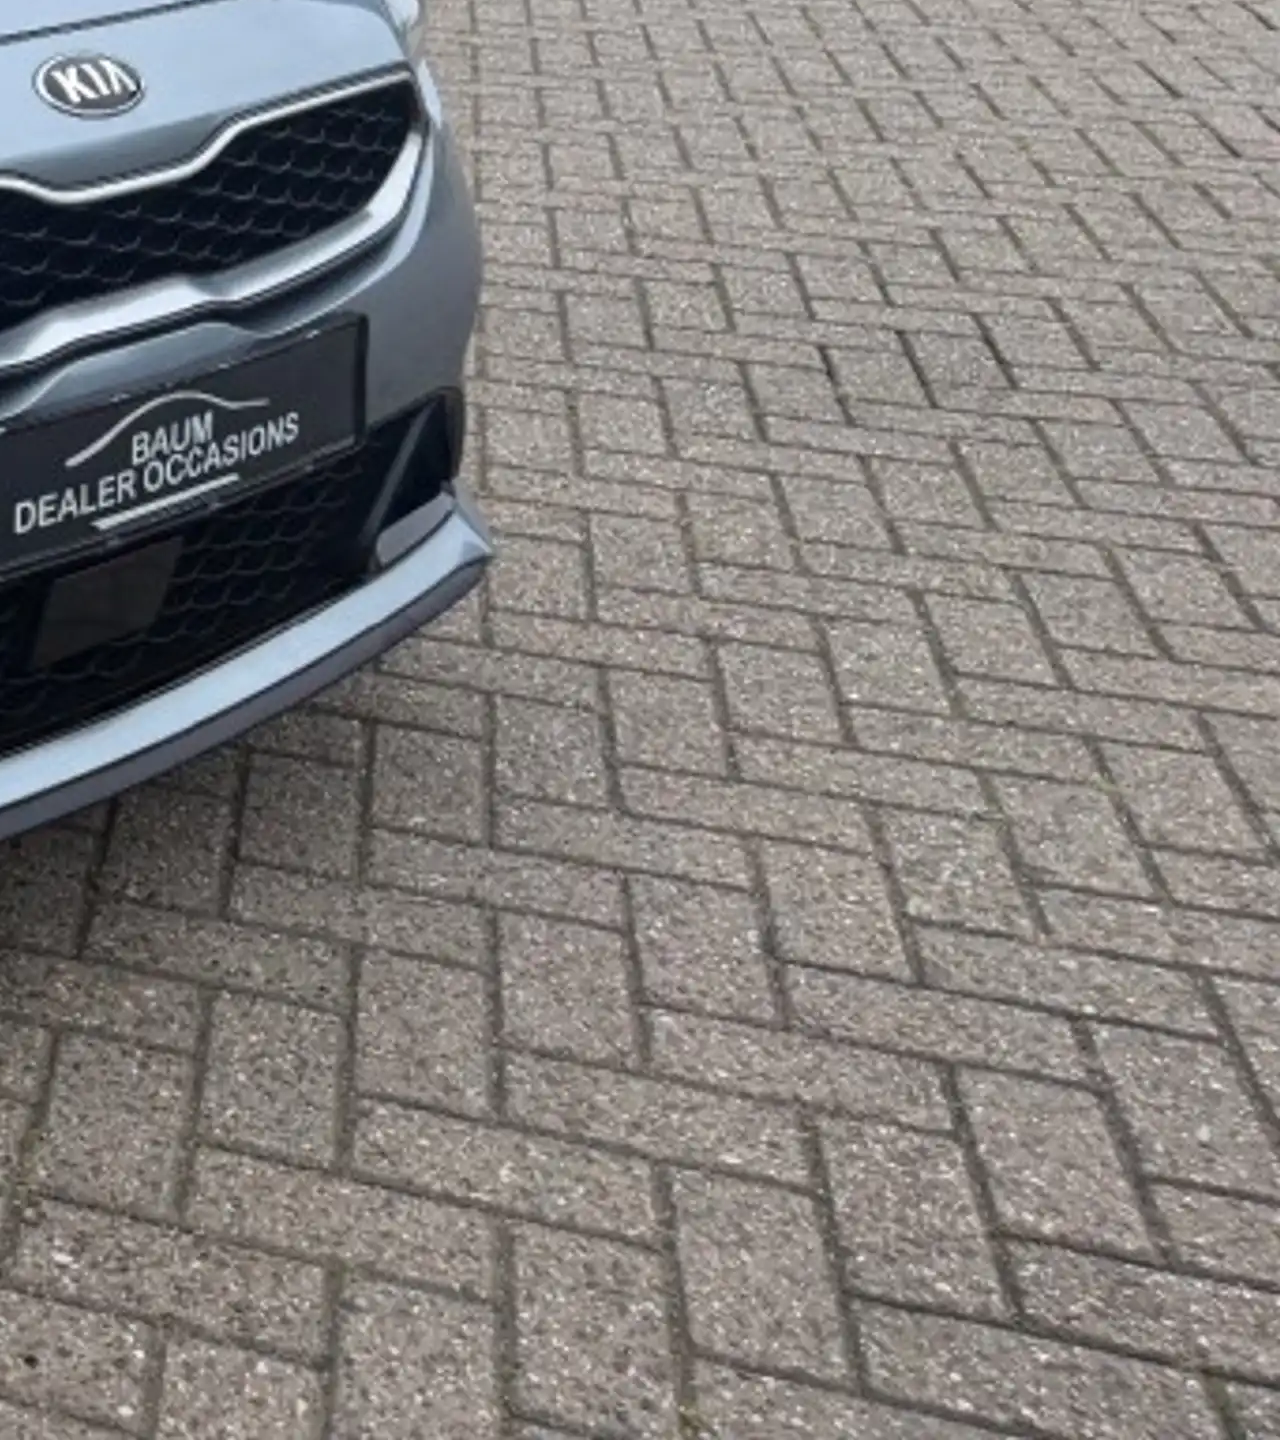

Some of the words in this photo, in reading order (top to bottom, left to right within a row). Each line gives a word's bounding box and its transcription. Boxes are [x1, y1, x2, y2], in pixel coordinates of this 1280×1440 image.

[51, 60, 137, 103] KIA
[132, 411, 213, 465] BAUM
[13, 469, 137, 534] DEALER
[143, 412, 300, 492] OCCASIONS
